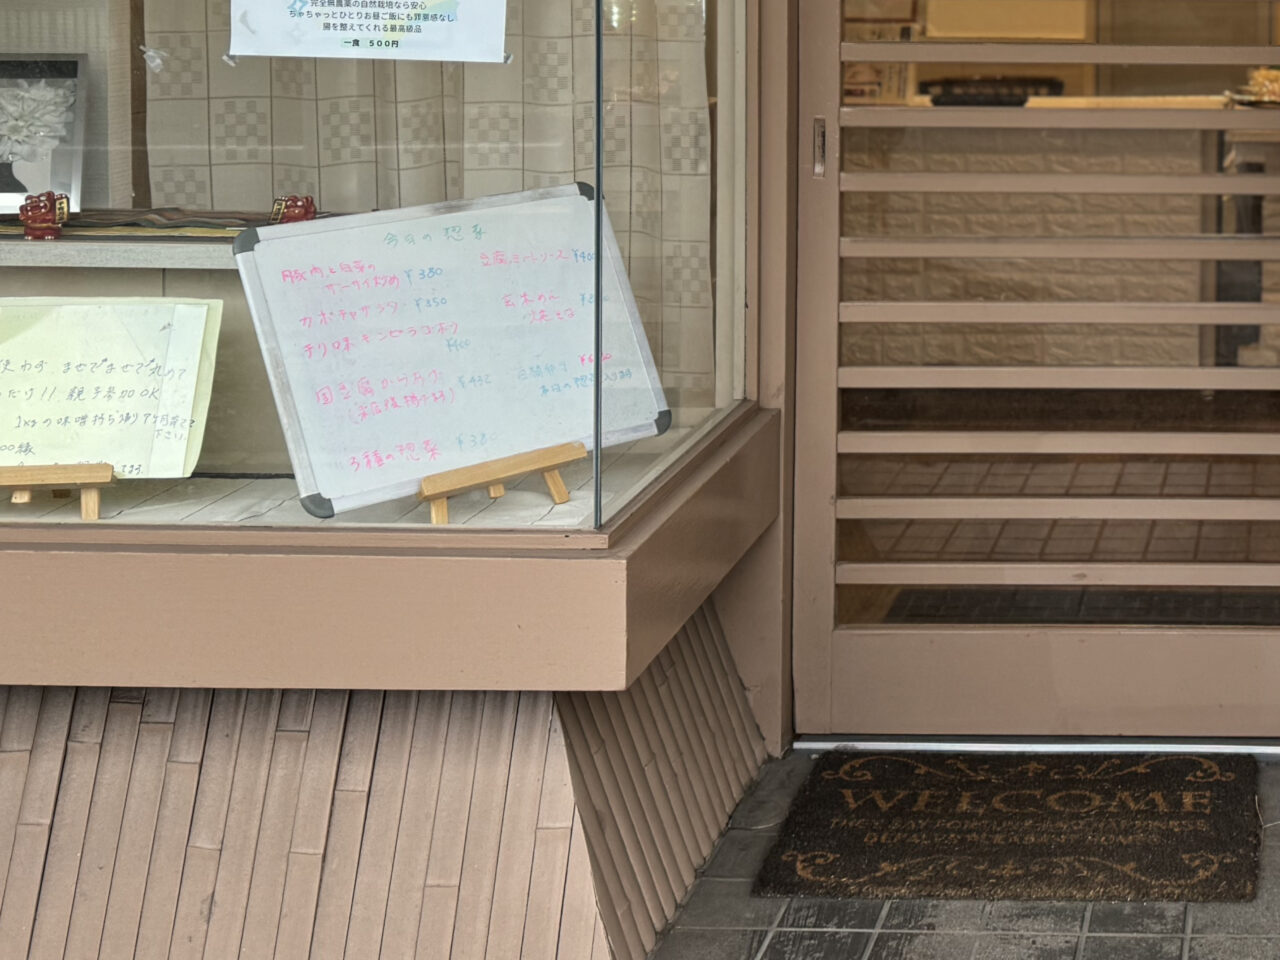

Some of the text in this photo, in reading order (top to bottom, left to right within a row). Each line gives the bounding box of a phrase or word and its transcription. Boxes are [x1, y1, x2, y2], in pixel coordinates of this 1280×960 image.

[289, 10, 454, 23] ちゃちゃっとひとりお昼ご飯にも罪悪感なし
[838, 787, 1213, 815] WELCOME
